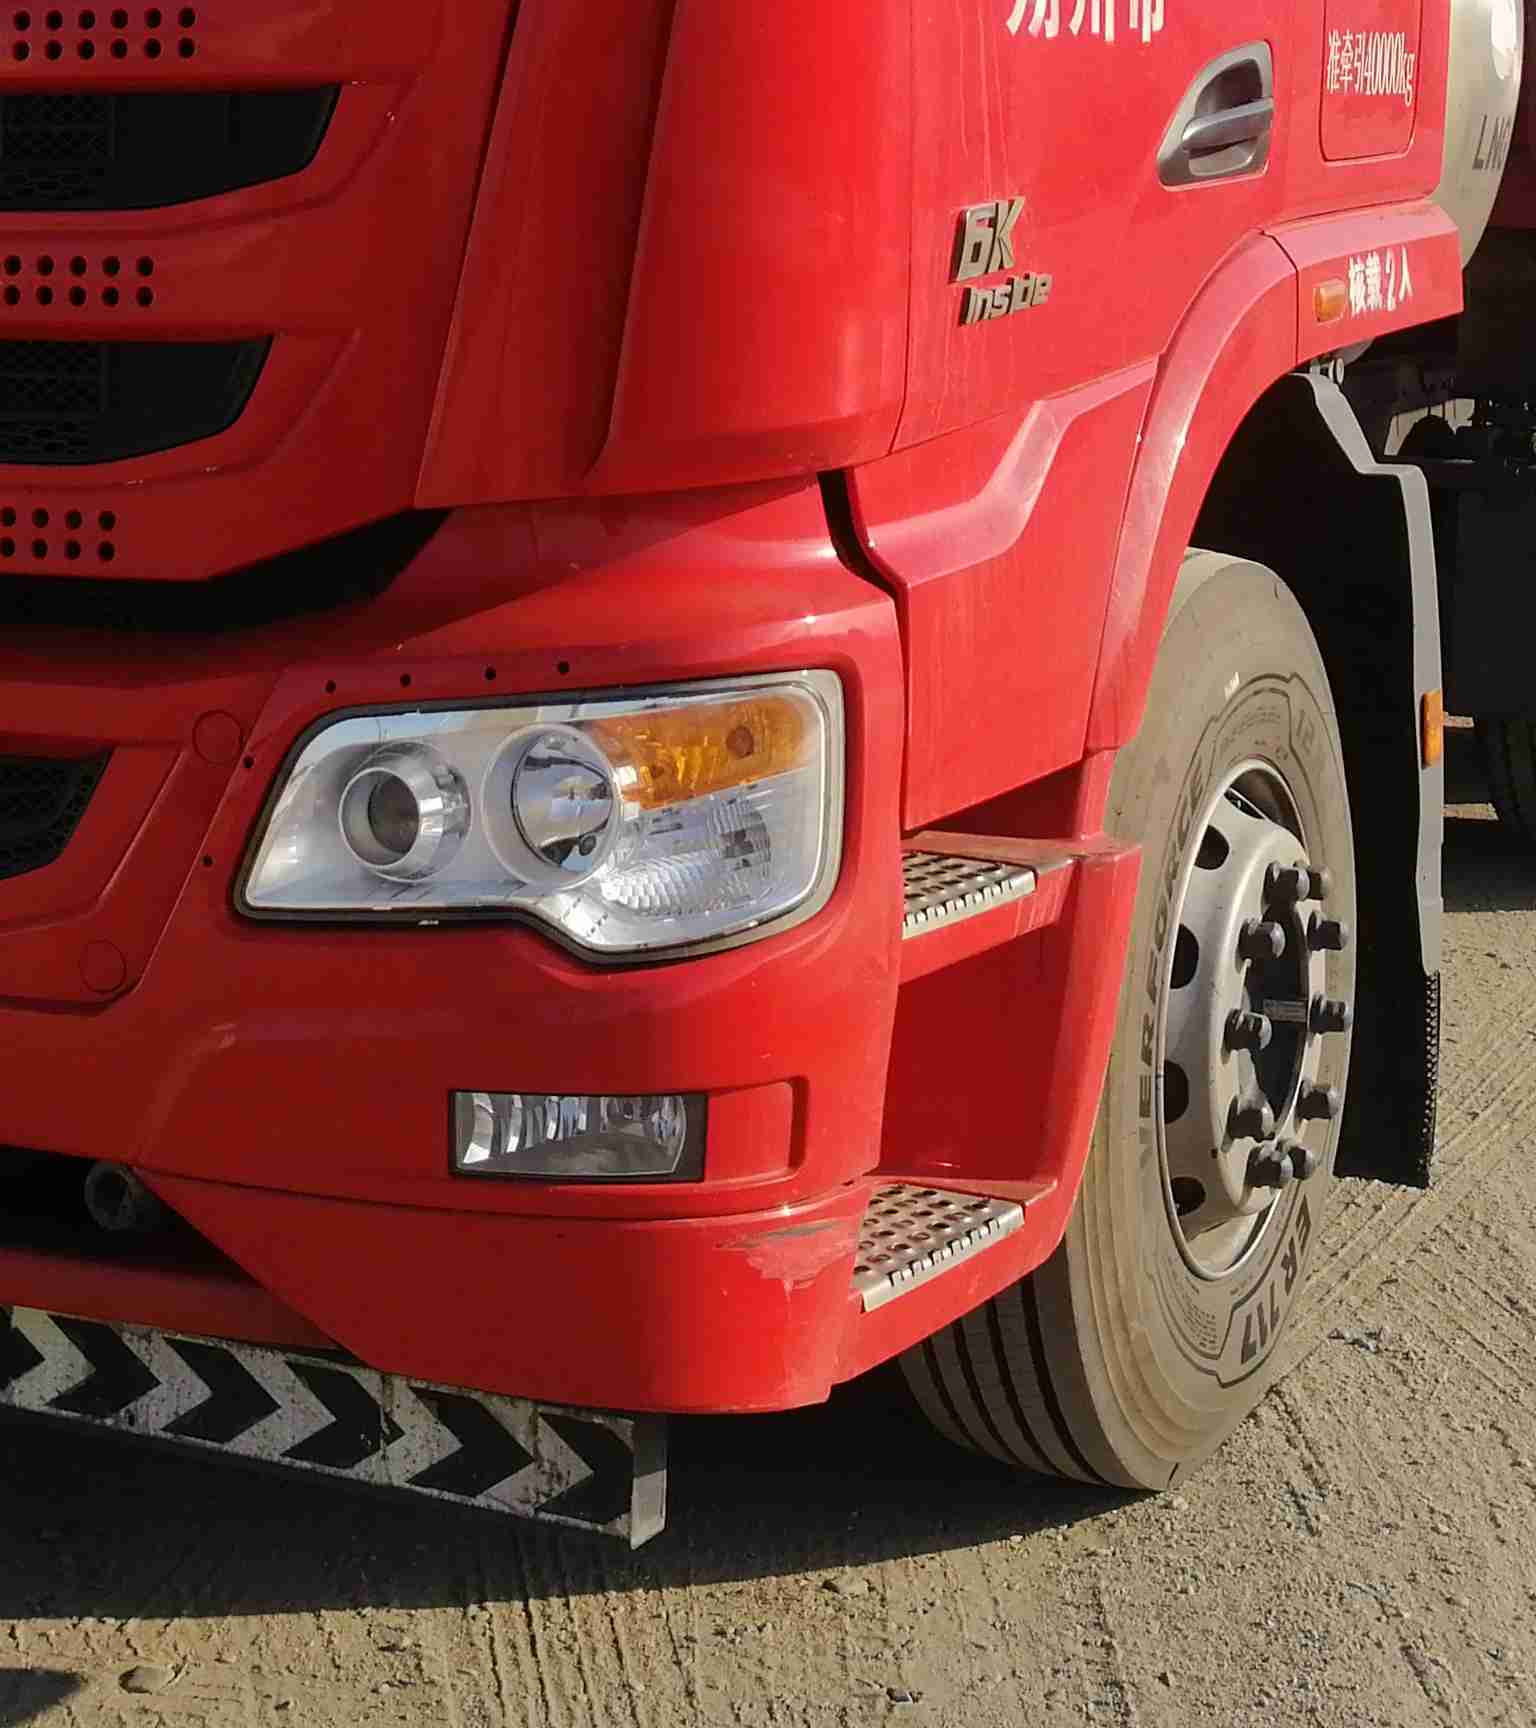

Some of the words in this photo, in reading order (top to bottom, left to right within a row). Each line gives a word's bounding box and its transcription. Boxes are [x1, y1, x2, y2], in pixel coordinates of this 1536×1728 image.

[1326, 28, 1416, 108] 准牵引40000kg
[953, 196, 1026, 284] 6K
